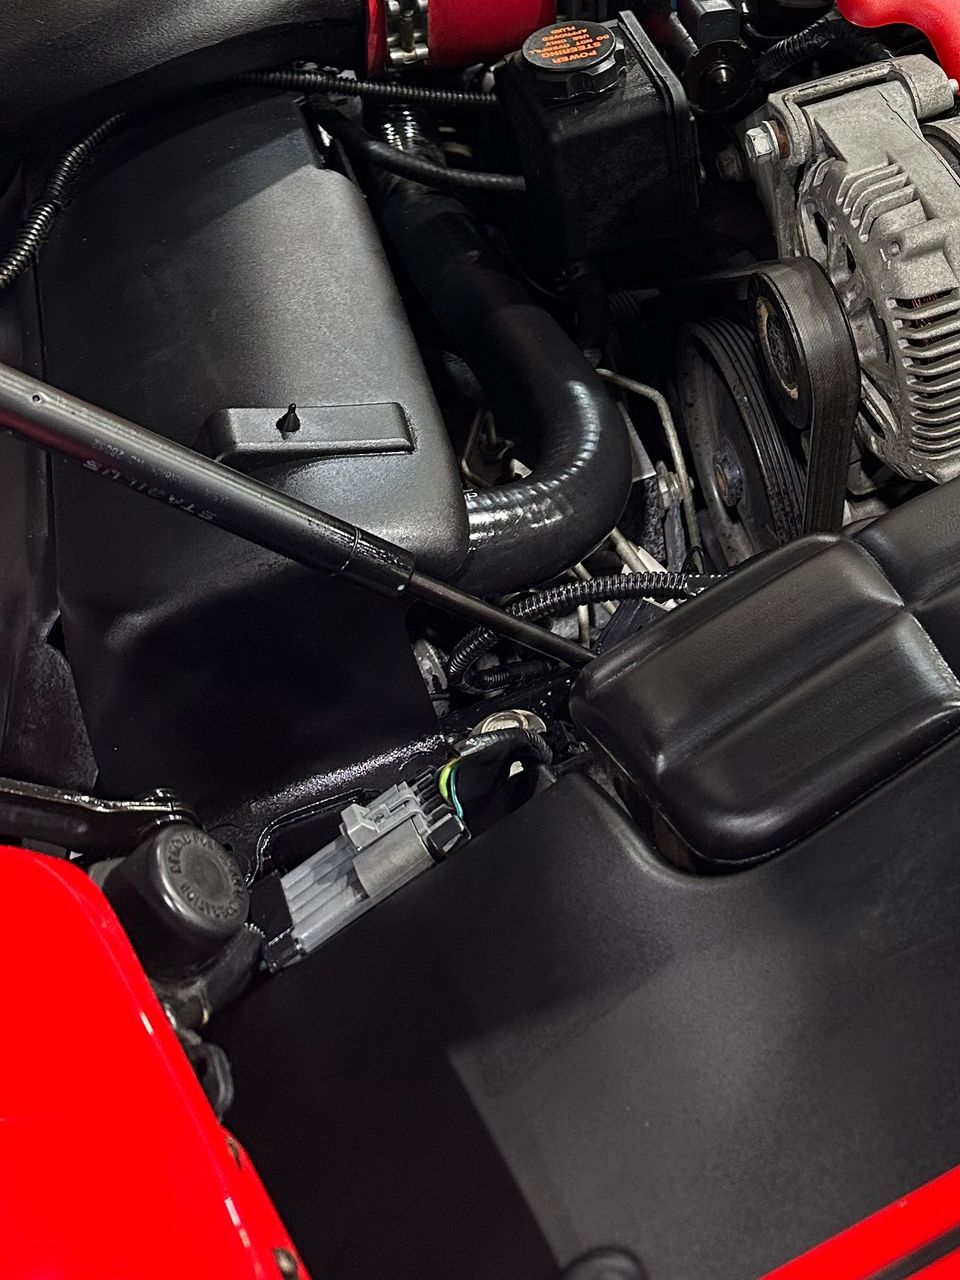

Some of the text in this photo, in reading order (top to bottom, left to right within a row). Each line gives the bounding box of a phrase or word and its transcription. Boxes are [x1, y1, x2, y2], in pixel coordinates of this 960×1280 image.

[542, 28, 586, 40] APPROVED
[541, 41, 600, 57] STEERING
[552, 50, 596, 62] POWER
